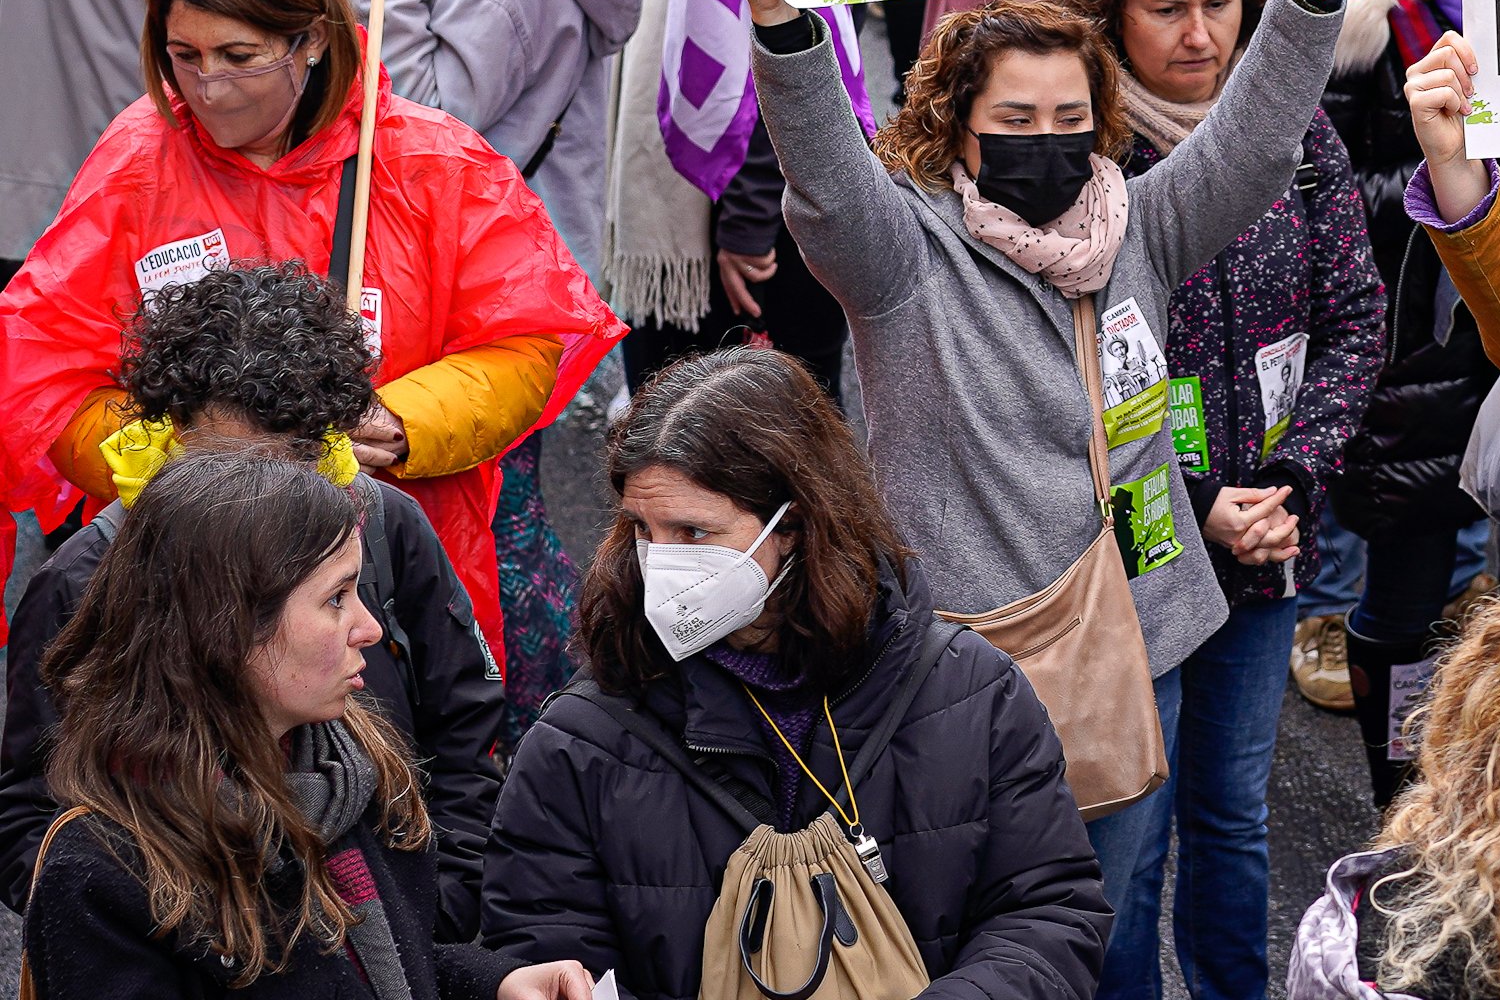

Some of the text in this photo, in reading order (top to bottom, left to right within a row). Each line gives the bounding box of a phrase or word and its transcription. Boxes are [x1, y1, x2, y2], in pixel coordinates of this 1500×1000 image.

[205, 235, 220, 247] UGT
[140, 239, 201, 273] L'EDUCACIÓ
[1106, 313, 1138, 335] DICTADOR
